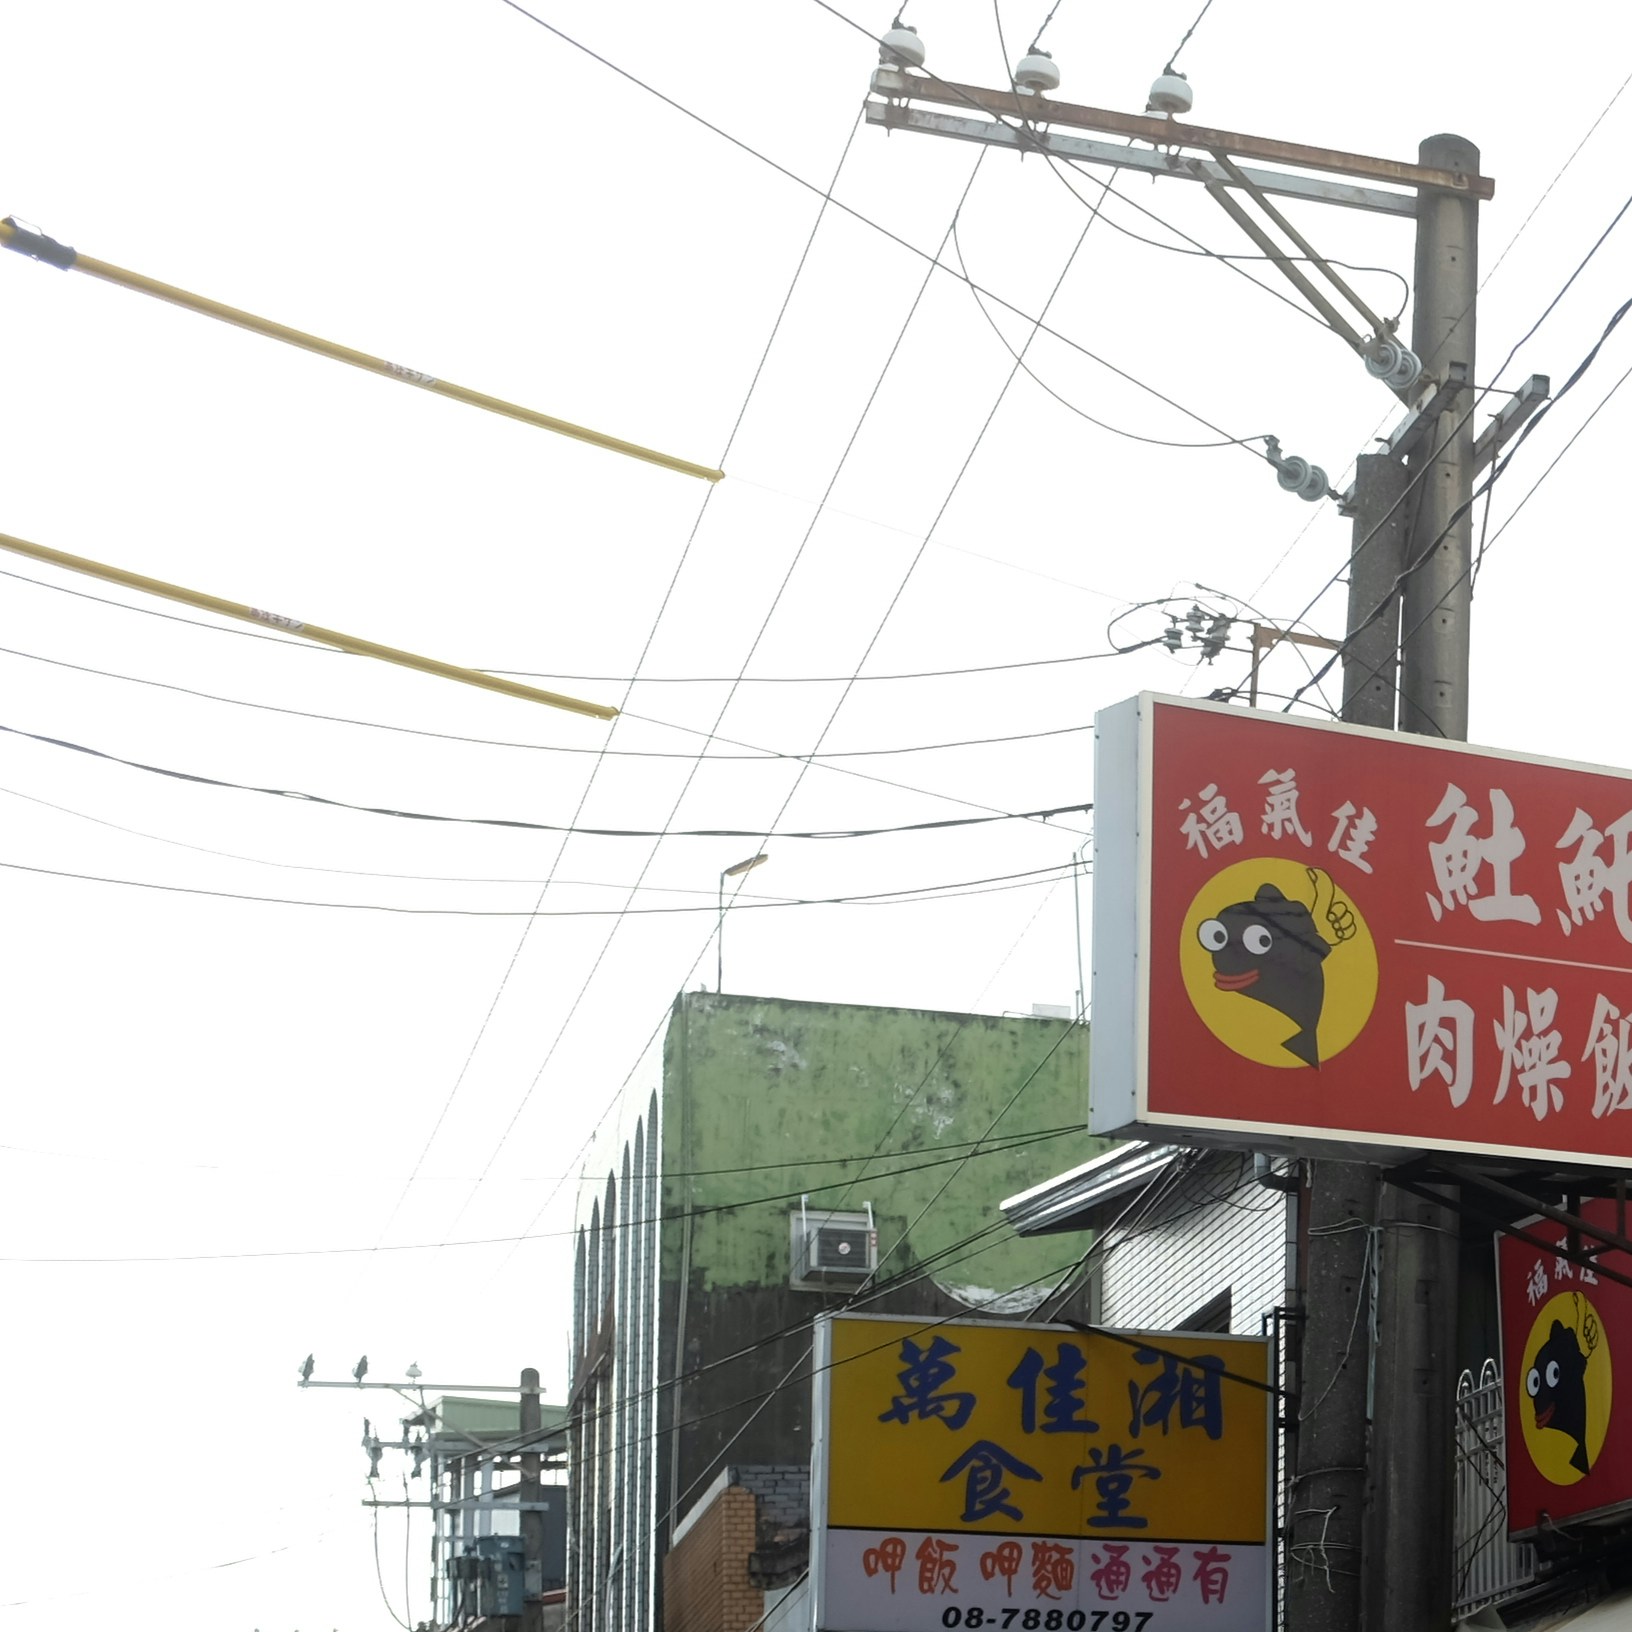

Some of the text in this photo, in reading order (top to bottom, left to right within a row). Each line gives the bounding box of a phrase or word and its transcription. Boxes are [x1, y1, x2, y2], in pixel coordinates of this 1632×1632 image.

[1177, 767, 1377, 875] 福氣佳
[940, 1440, 1161, 1528] 食堂
[863, 1537, 1231, 1604] 呷飯 呷麵 通通有
[942, 1607, 1153, 1632] 08-7880797
